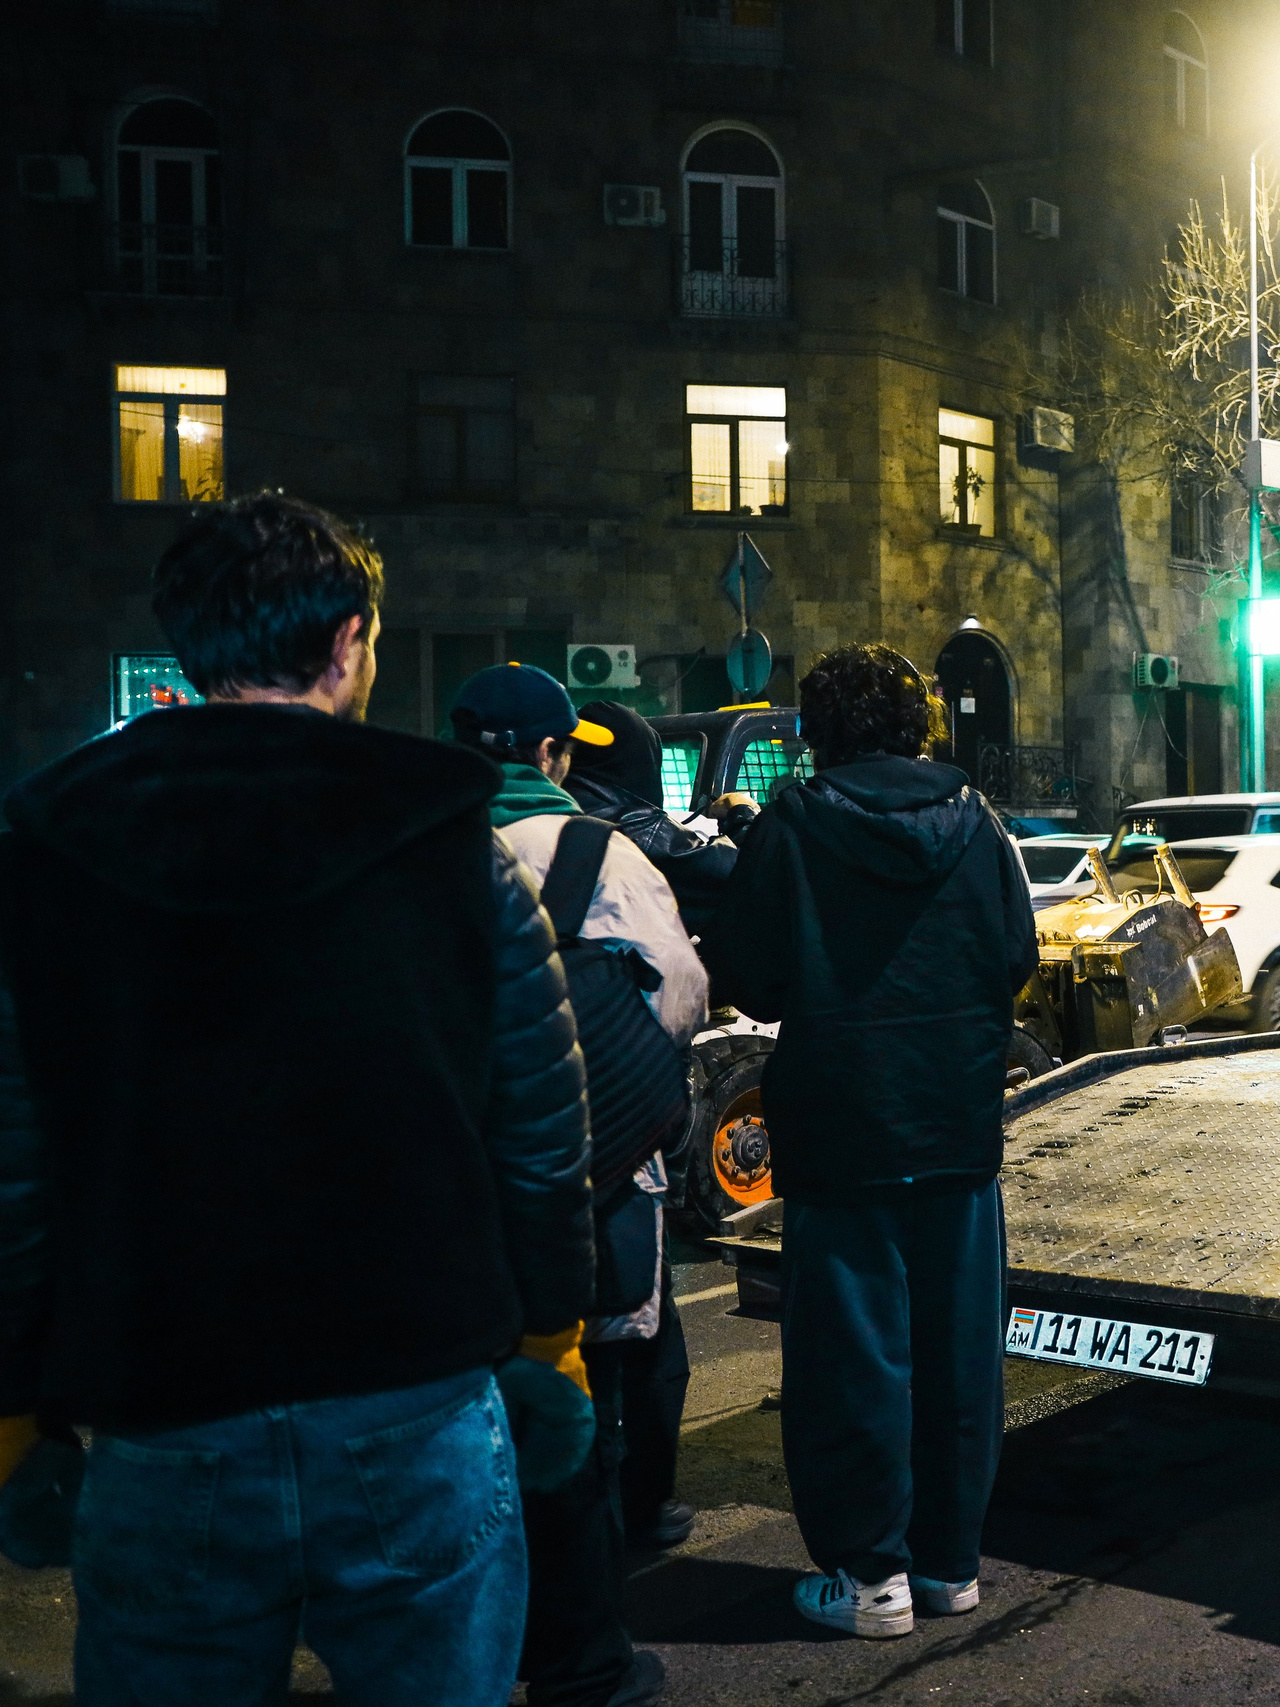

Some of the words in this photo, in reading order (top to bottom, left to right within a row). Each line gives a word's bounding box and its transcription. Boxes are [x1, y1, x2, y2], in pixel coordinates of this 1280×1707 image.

[1136, 913, 1157, 933] Bobcat
[1008, 1331, 1030, 1347] AM
[1043, 1314, 1081, 1356] 11
[1090, 1321, 1131, 1365] WA
[1139, 1329, 1200, 1375] 211
